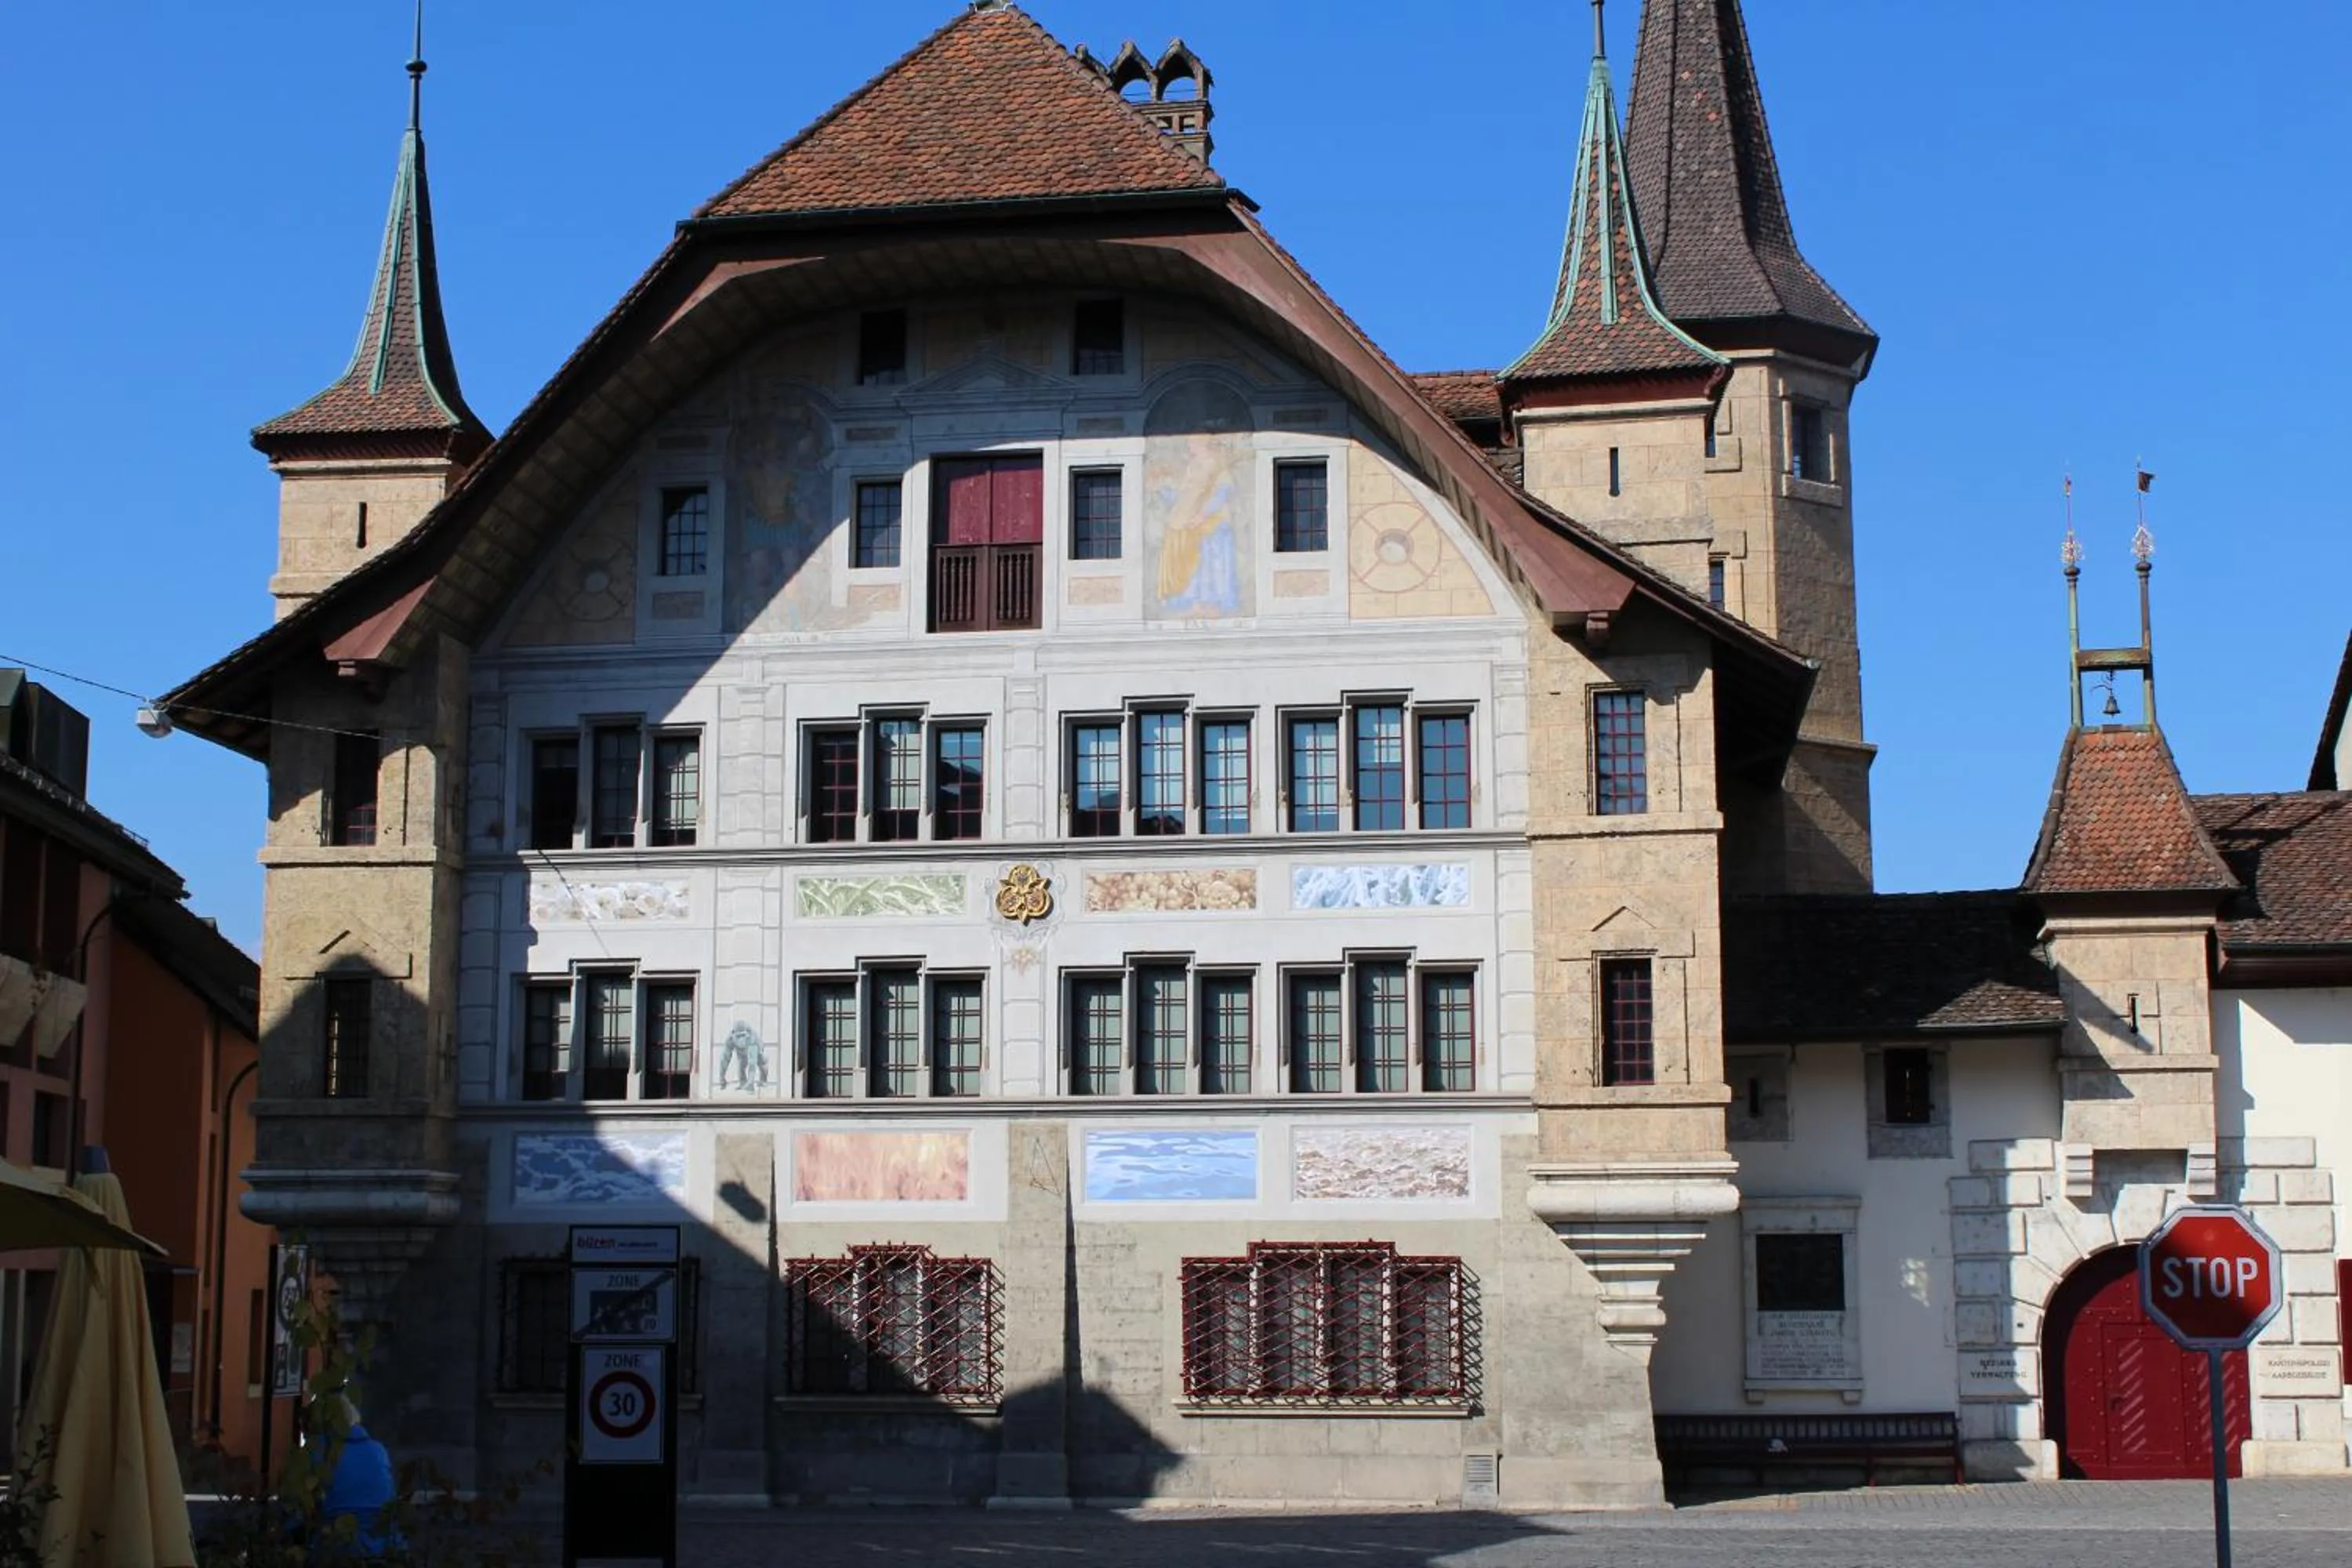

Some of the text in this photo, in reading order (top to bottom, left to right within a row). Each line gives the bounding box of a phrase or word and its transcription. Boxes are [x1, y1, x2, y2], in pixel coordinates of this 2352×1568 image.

[606, 1273, 641, 1288] ZONE
[2162, 1257, 2258, 1298] STOP
[604, 1354, 641, 1368] ZONE
[608, 1392, 636, 1417] 30
